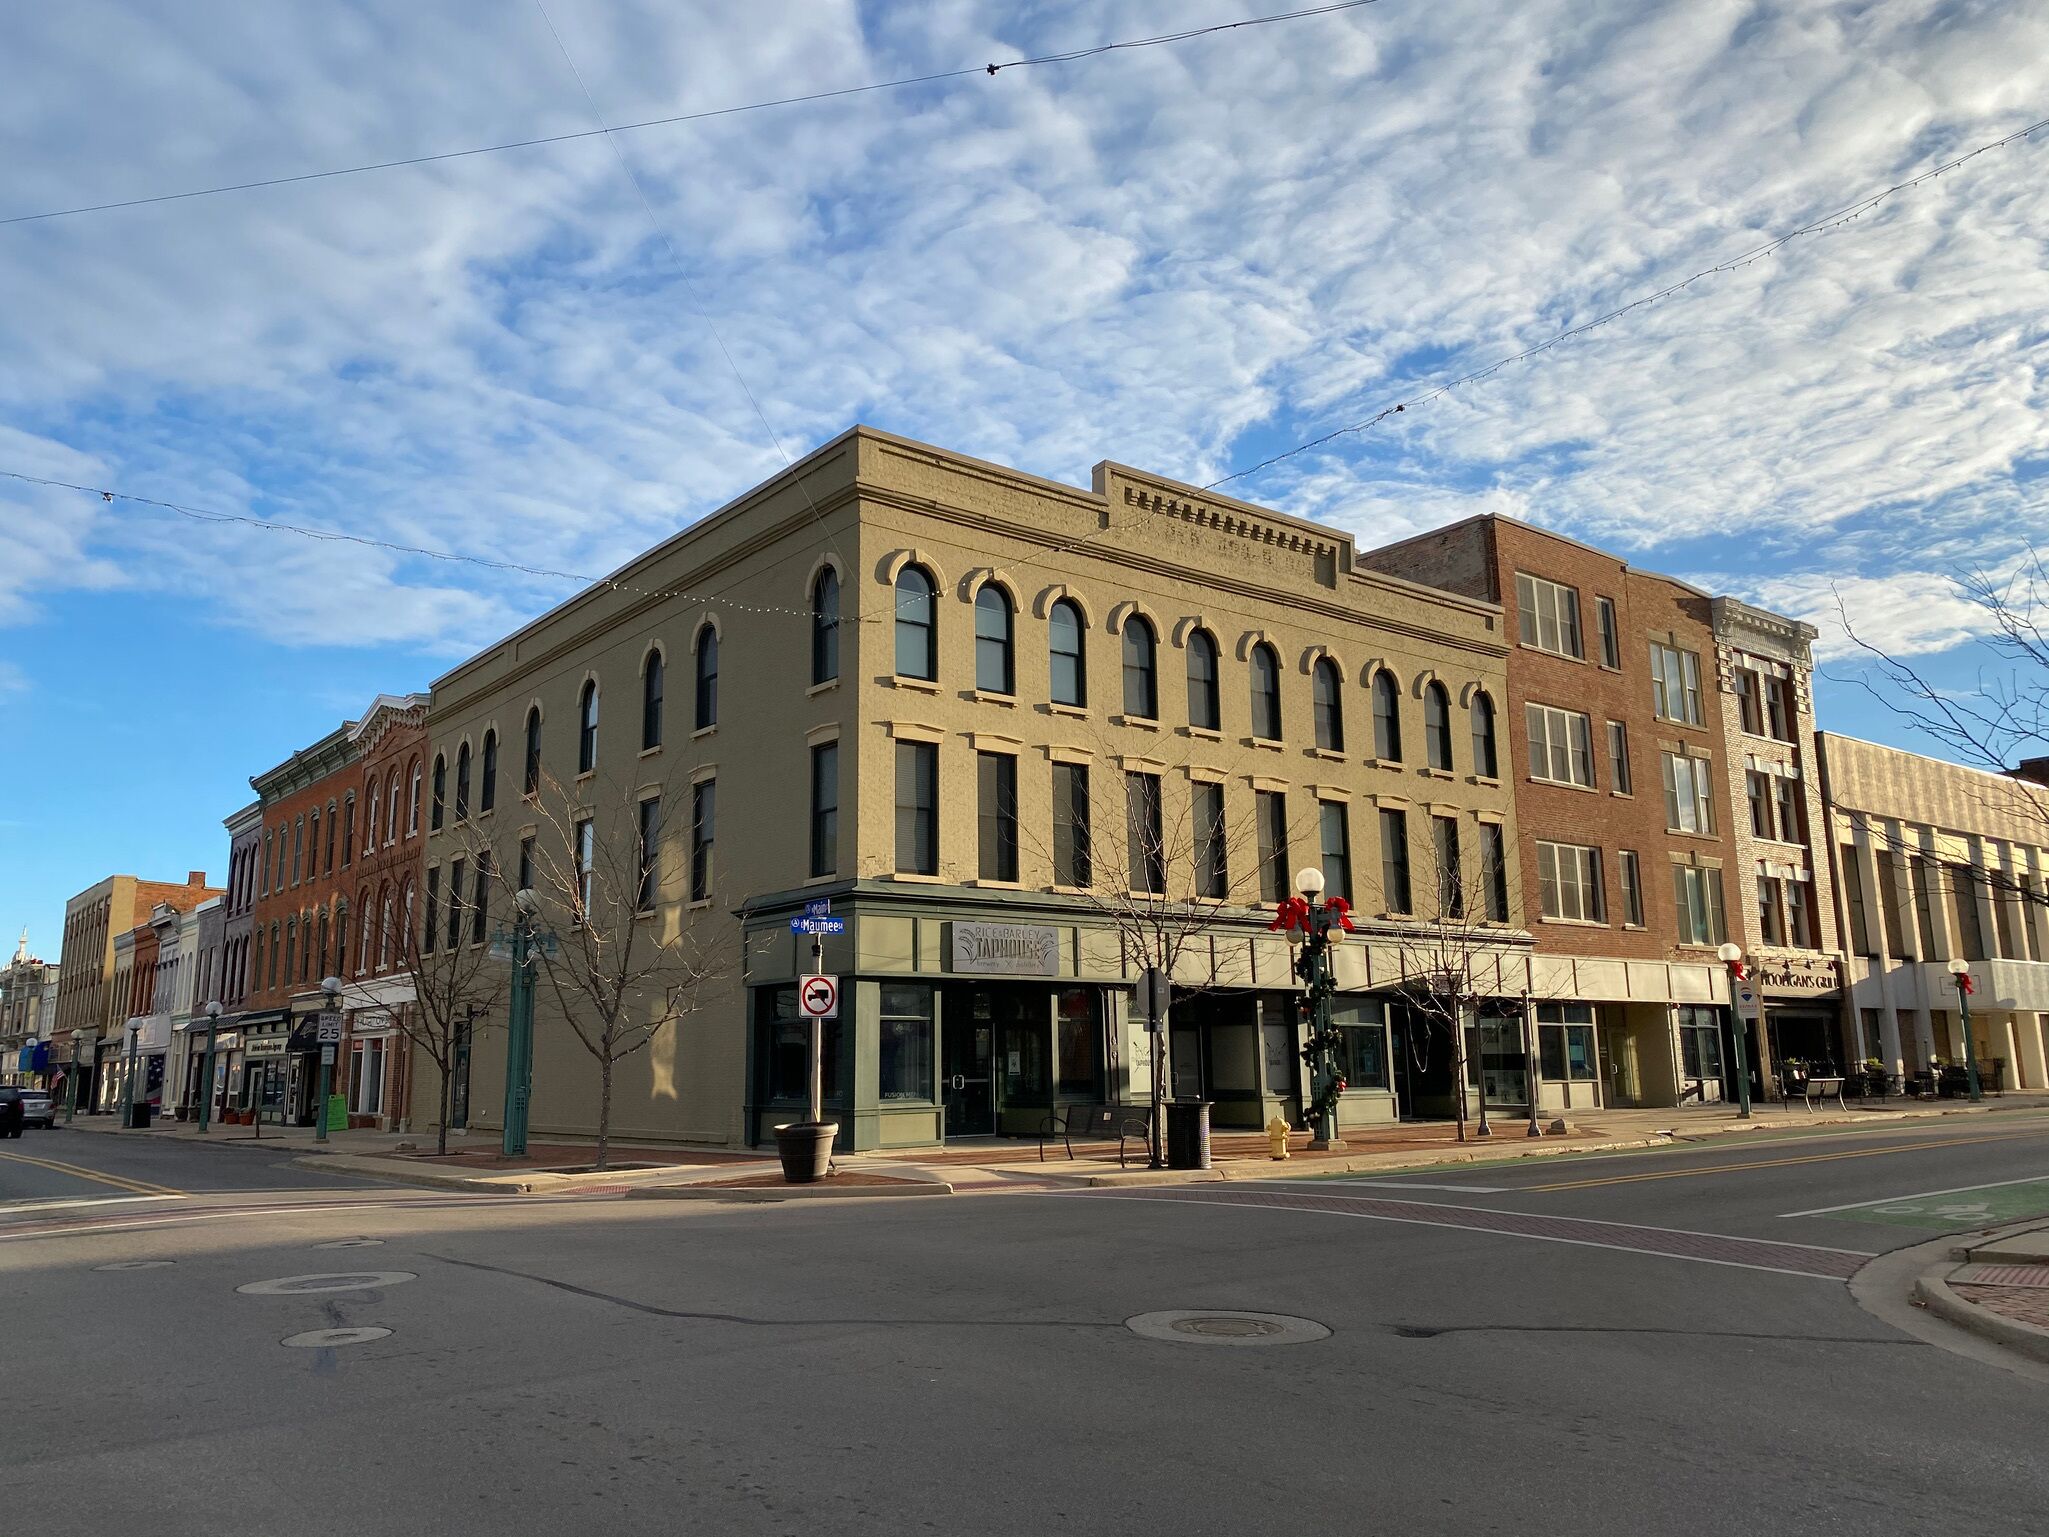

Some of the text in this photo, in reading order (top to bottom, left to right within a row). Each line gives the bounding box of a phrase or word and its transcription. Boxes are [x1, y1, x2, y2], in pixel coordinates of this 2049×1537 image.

[803, 919, 839, 932] Maumee
[975, 927, 998, 938] RICE
[1003, 928, 1040, 939] BARLEY
[975, 937, 1041, 960] TAPHOUSE
[320, 1028, 339, 1039] 25
